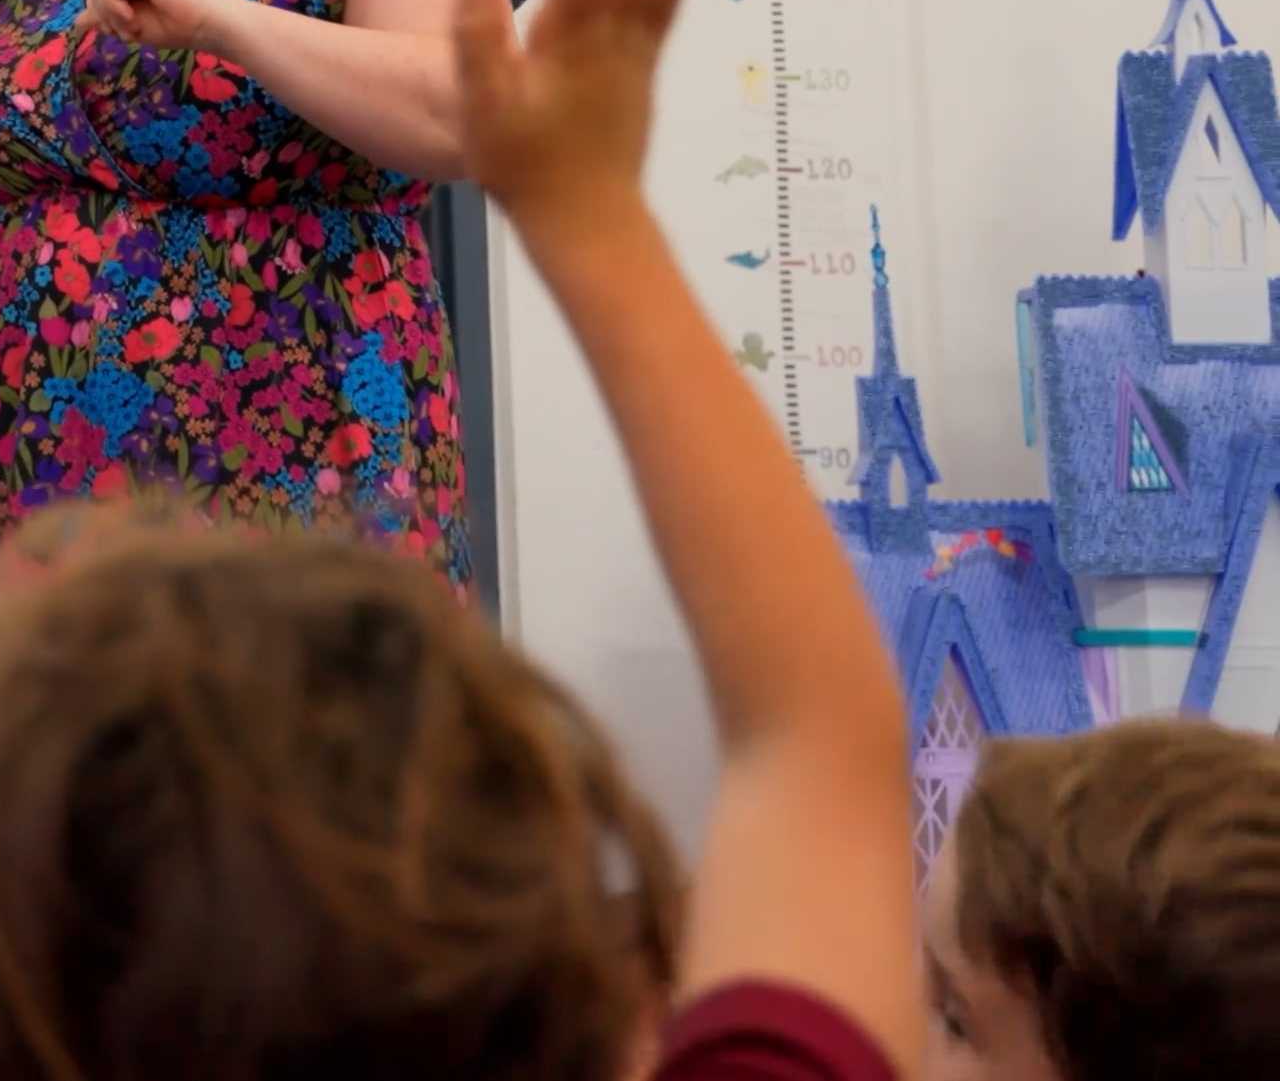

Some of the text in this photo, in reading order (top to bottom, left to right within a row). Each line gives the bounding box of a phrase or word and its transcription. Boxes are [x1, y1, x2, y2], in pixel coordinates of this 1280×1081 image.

[806, 159, 852, 180] 120
[809, 254, 855, 275] 110
[815, 346, 862, 367] 100
[819, 448, 851, 468] 90
